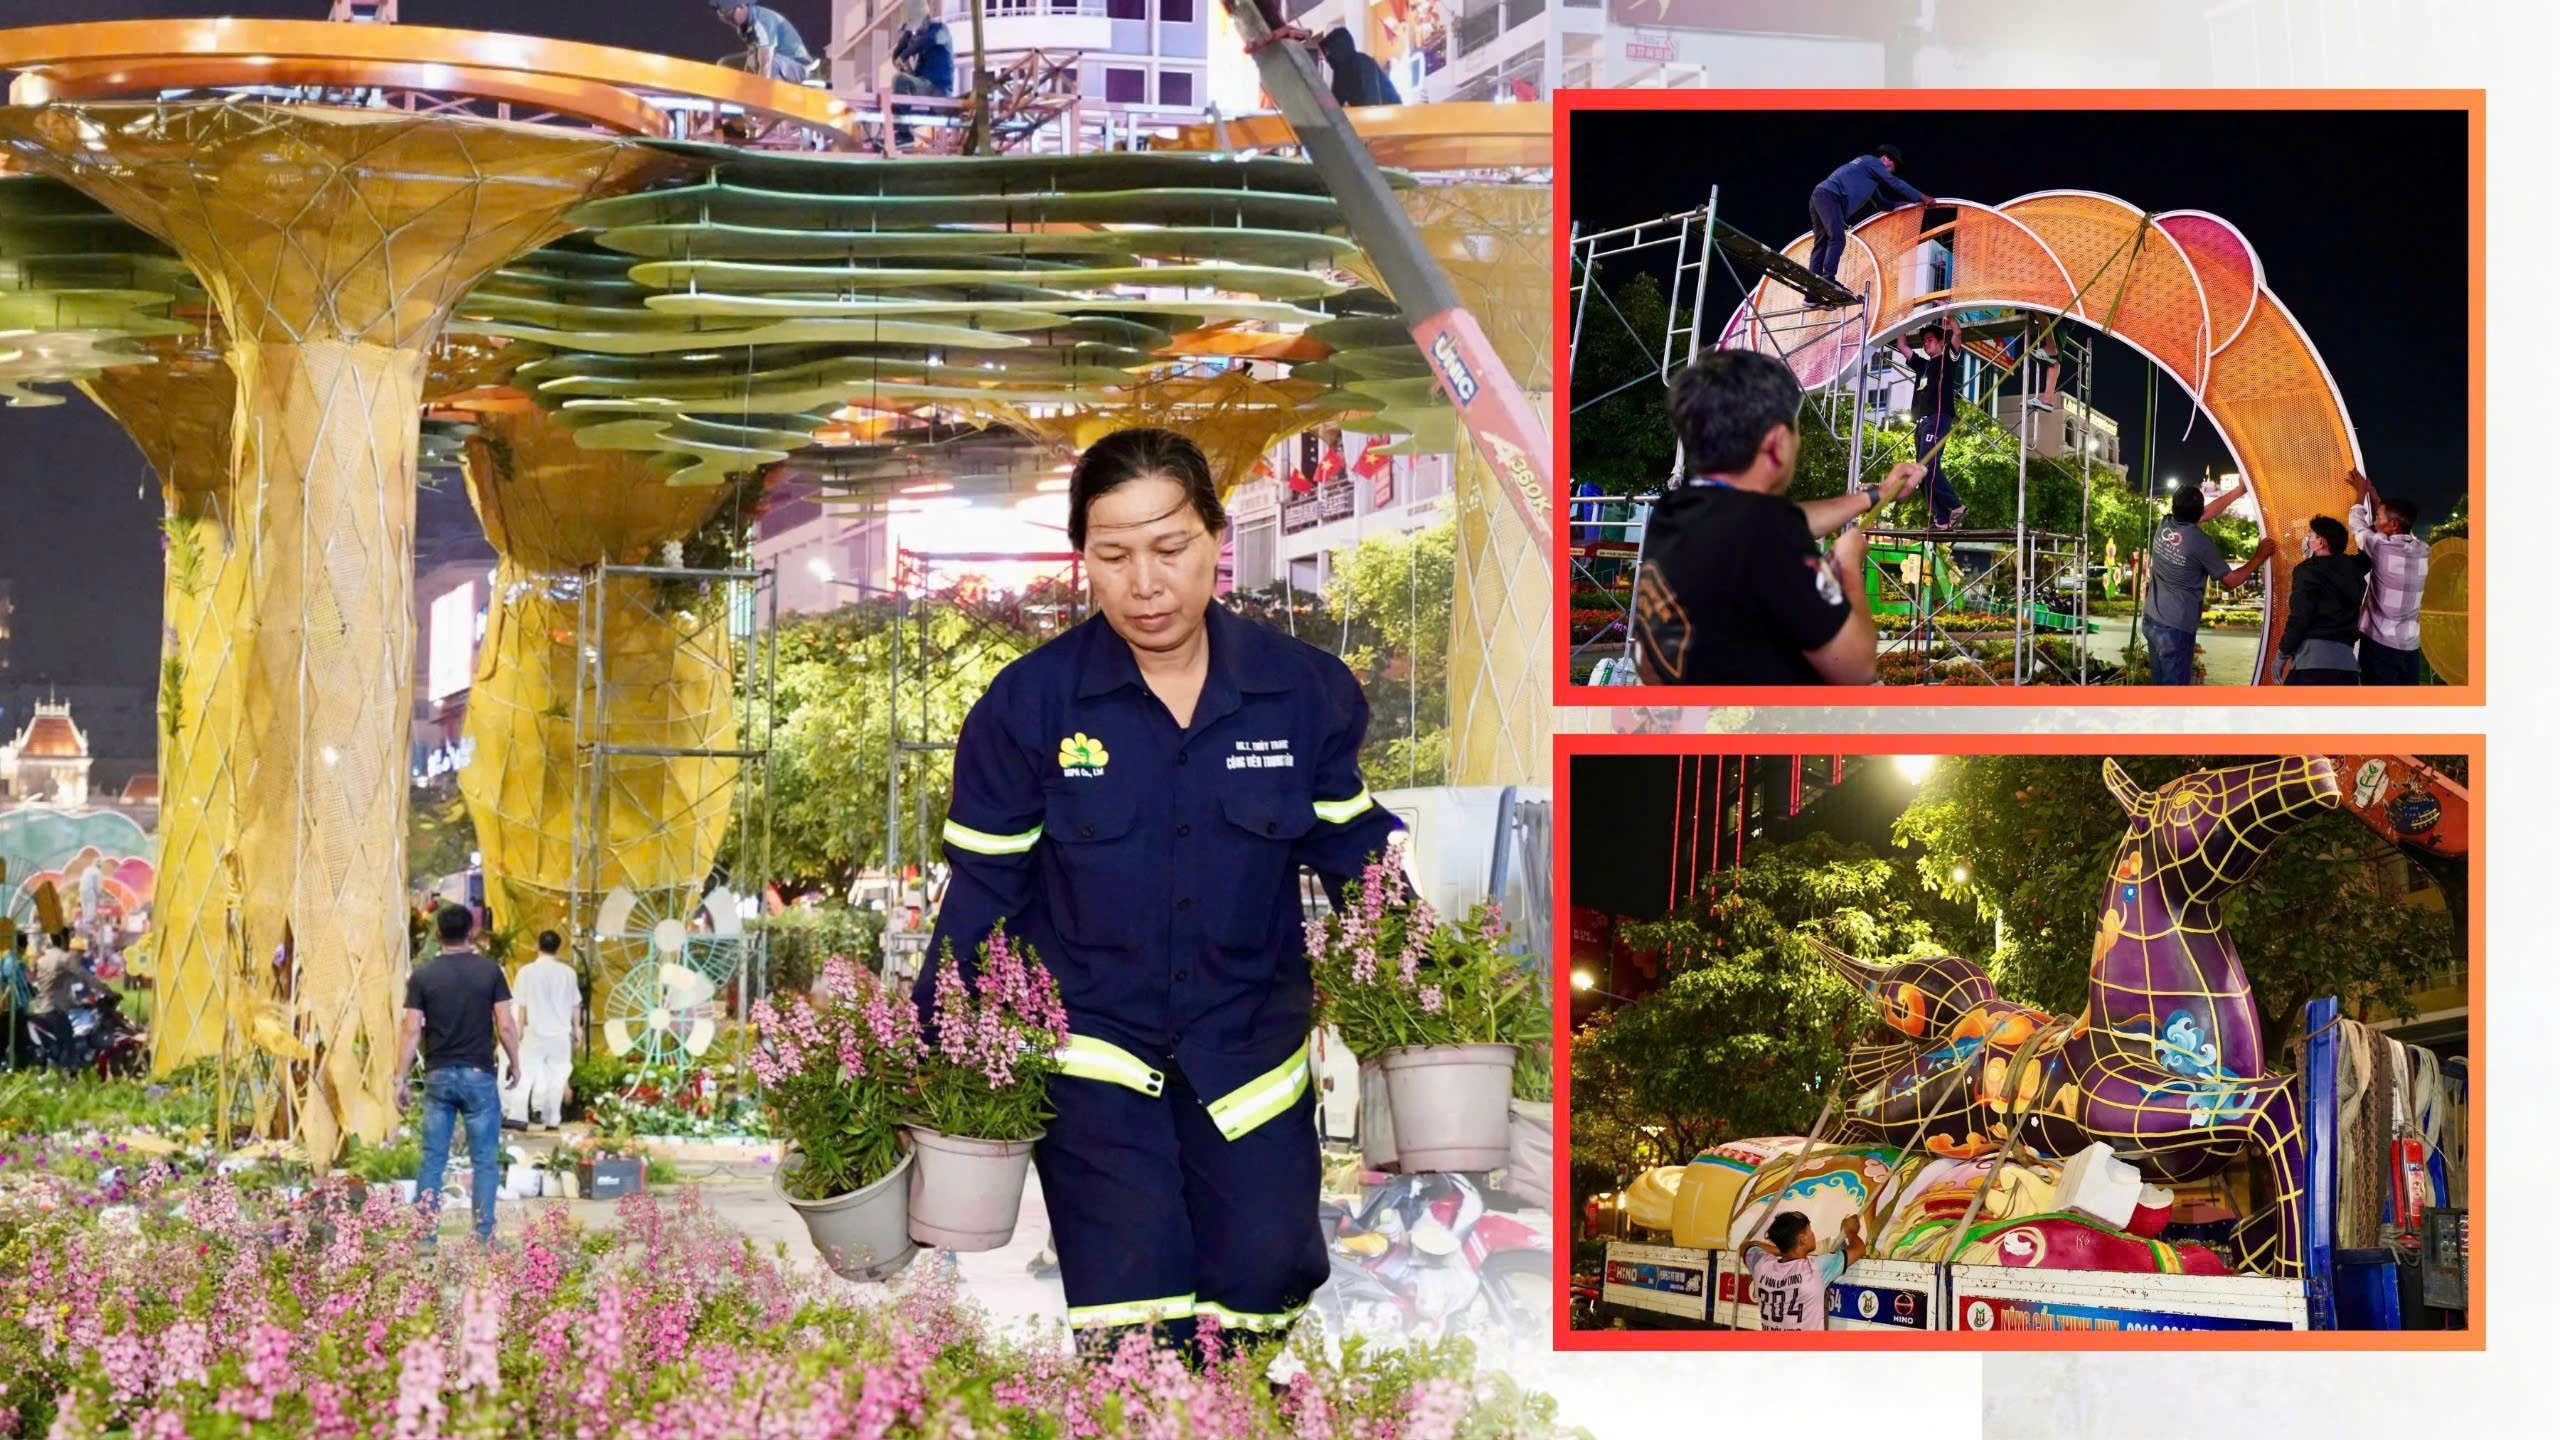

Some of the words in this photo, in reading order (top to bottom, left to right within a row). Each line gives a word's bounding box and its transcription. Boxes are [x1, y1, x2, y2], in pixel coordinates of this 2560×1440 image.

[1433, 334, 1475, 401] UNIC
[1616, 1266, 1637, 1282] HINO
[1758, 1287, 1803, 1323] 204
[1893, 1315, 1914, 1325] HINO
